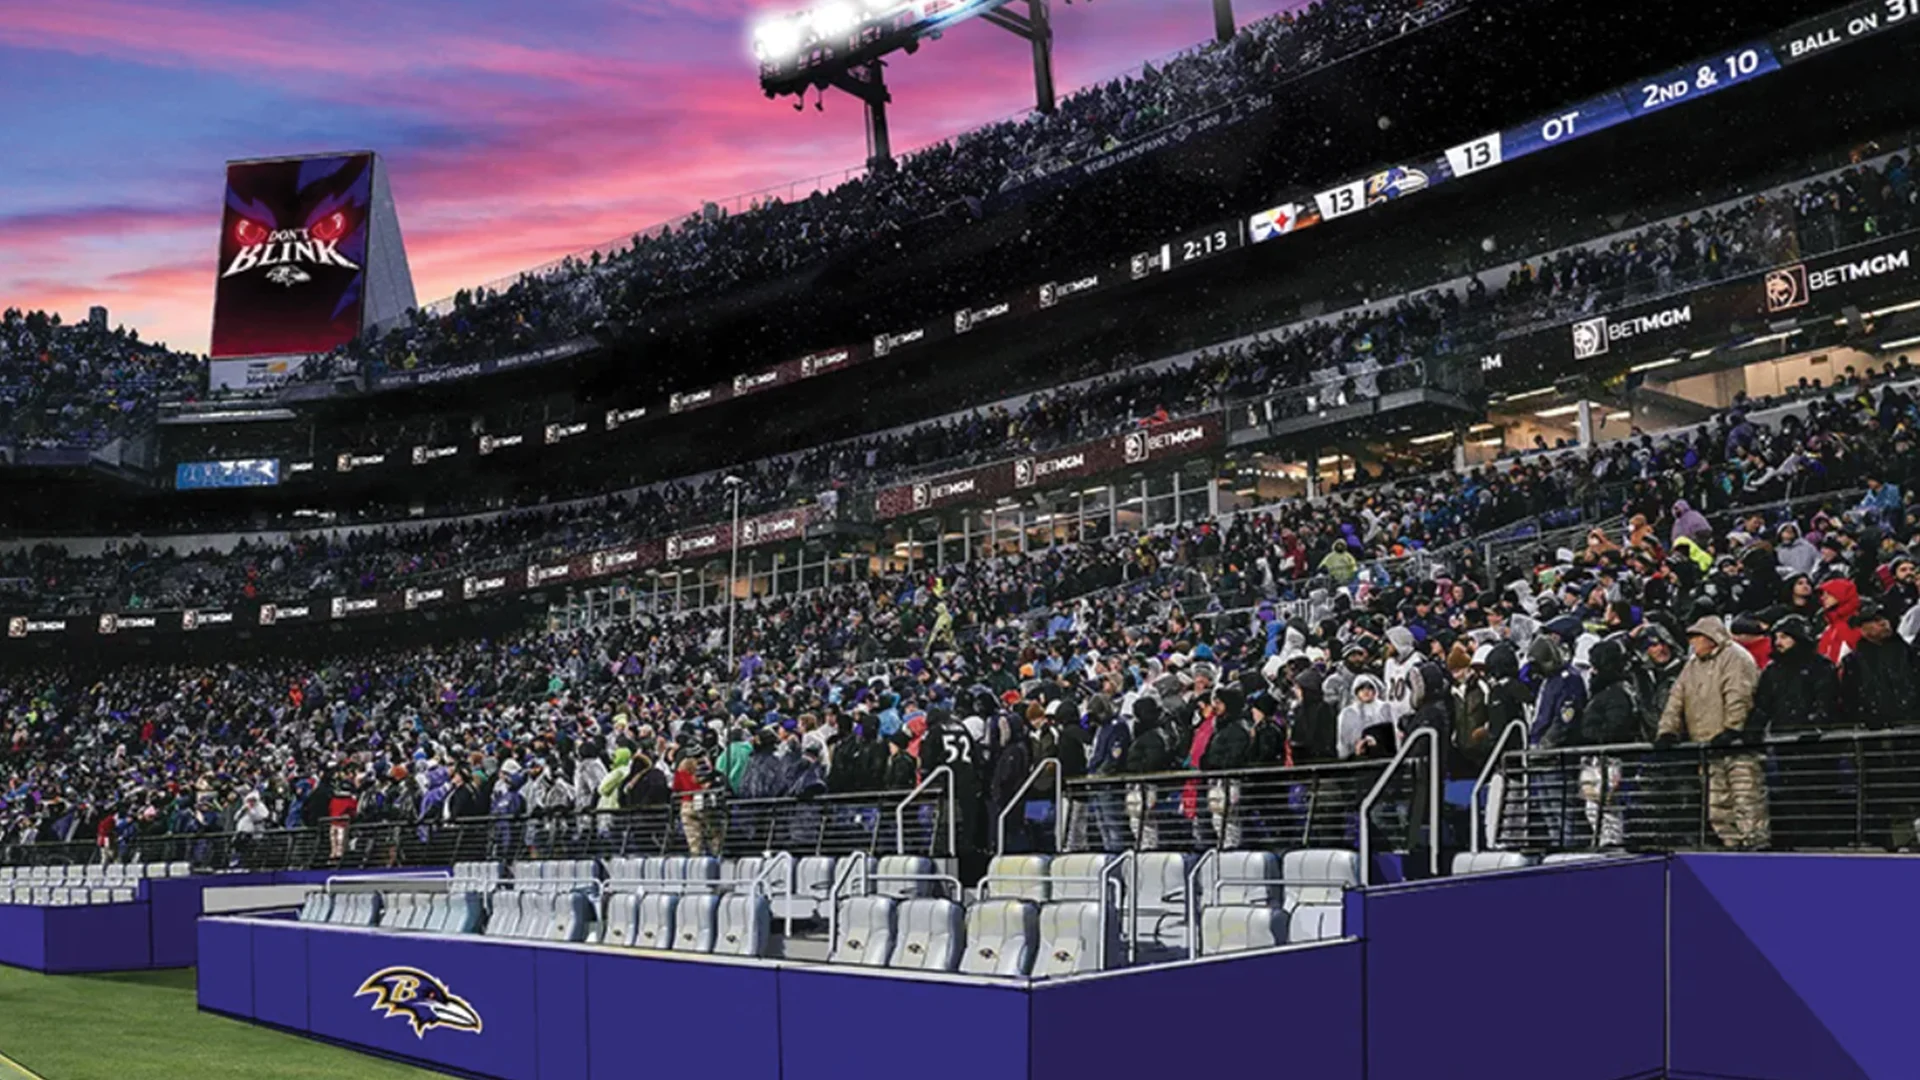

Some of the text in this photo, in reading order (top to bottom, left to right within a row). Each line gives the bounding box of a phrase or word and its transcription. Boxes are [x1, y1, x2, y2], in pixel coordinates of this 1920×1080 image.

[1790, 28, 1841, 57] BALL
[1848, 12, 1878, 36] ON
[1641, 49, 1759, 108] 2ND & 10
[1542, 111, 1580, 141] OT
[1463, 141, 1491, 170] 13
[1329, 188, 1354, 214] 13
[221, 238, 360, 278] BLINK
[1183, 231, 1227, 261] 2:13
[1809, 249, 1909, 291] BETMGM
[1608, 305, 1692, 341] BETMGM
[1148, 427, 1204, 450] BETMGM
[1035, 453, 1085, 476] BETMGM
[930, 479, 974, 500] BETMGM
[942, 734, 972, 763] 52
